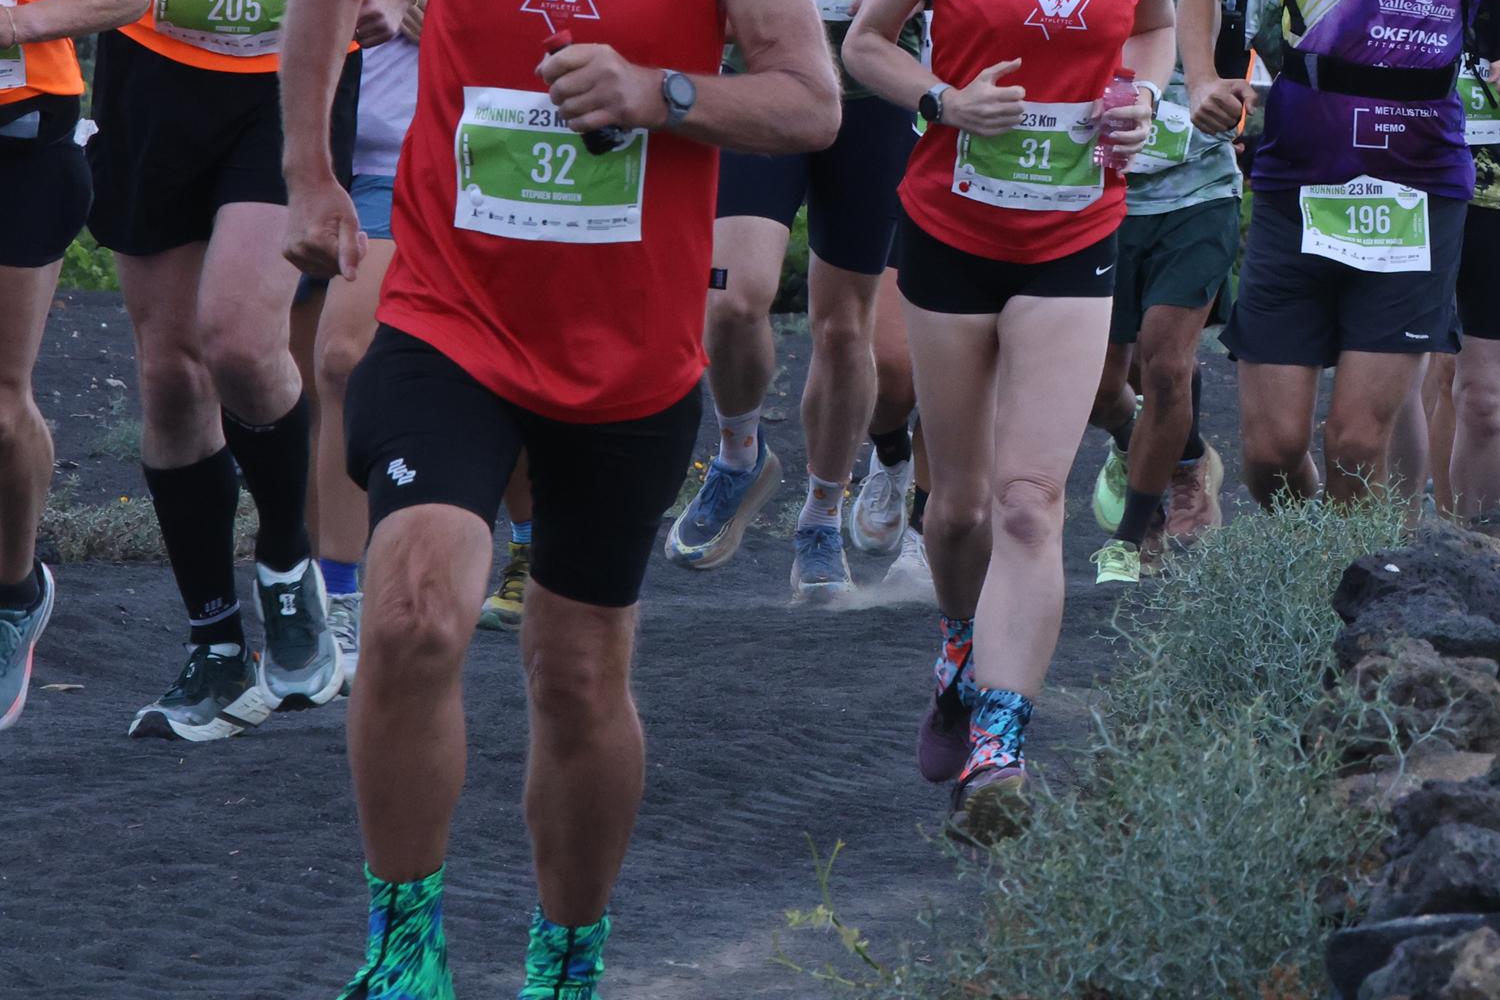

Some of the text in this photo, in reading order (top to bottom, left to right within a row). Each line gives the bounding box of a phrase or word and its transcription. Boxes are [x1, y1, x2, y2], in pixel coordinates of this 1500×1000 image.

[475, 106, 525, 124] RUNNING
[528, 108, 552, 127] 23
[1020, 113, 1057, 127] 23 Km
[1146, 124, 1159, 146] 8
[1374, 123, 1406, 133] HEMO
[530, 142, 578, 186] 32
[1018, 138, 1052, 170] 31
[1310, 183, 1383, 195] RUNNING 23 Km
[1345, 205, 1391, 234] 196
